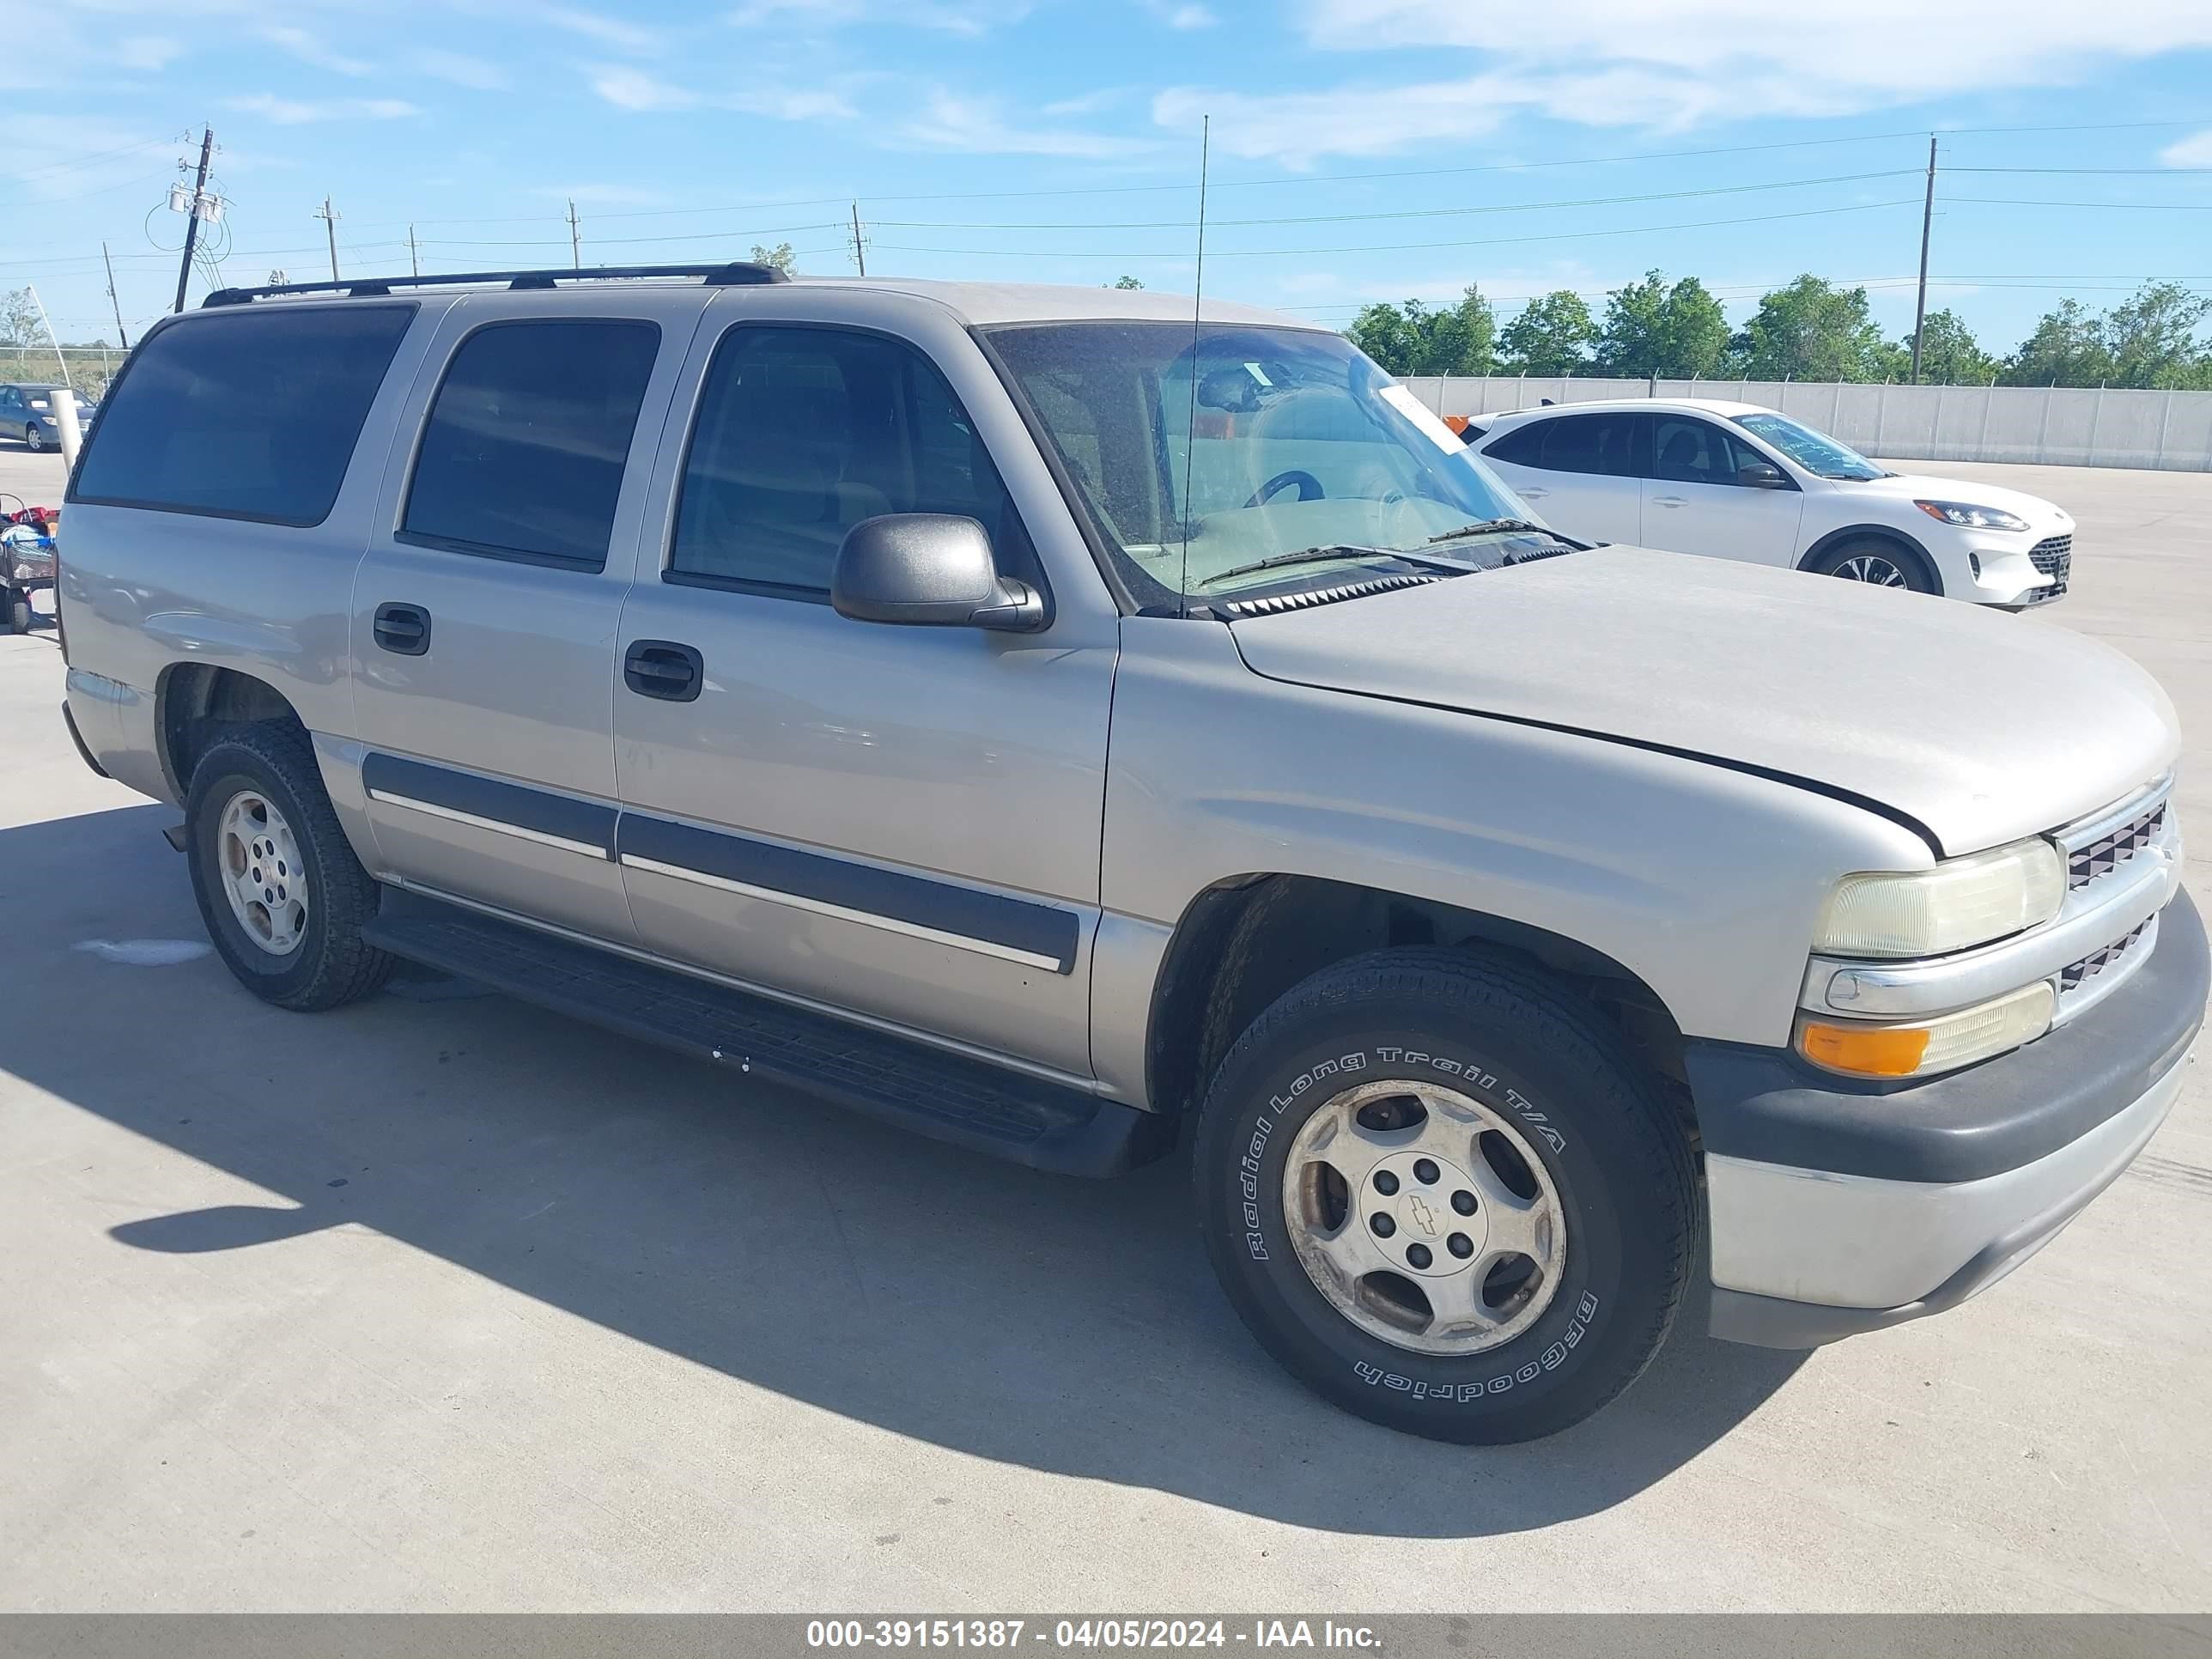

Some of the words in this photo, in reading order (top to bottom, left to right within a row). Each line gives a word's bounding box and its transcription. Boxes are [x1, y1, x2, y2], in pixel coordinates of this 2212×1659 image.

[1241, 1116, 1273, 1261] Radial
[1269, 1051, 1367, 1115] Long
[1376, 1047, 1498, 1090] Trail
[1505, 1087, 1567, 1154] T/A
[1353, 1290, 1600, 1402] BFGoodrich
